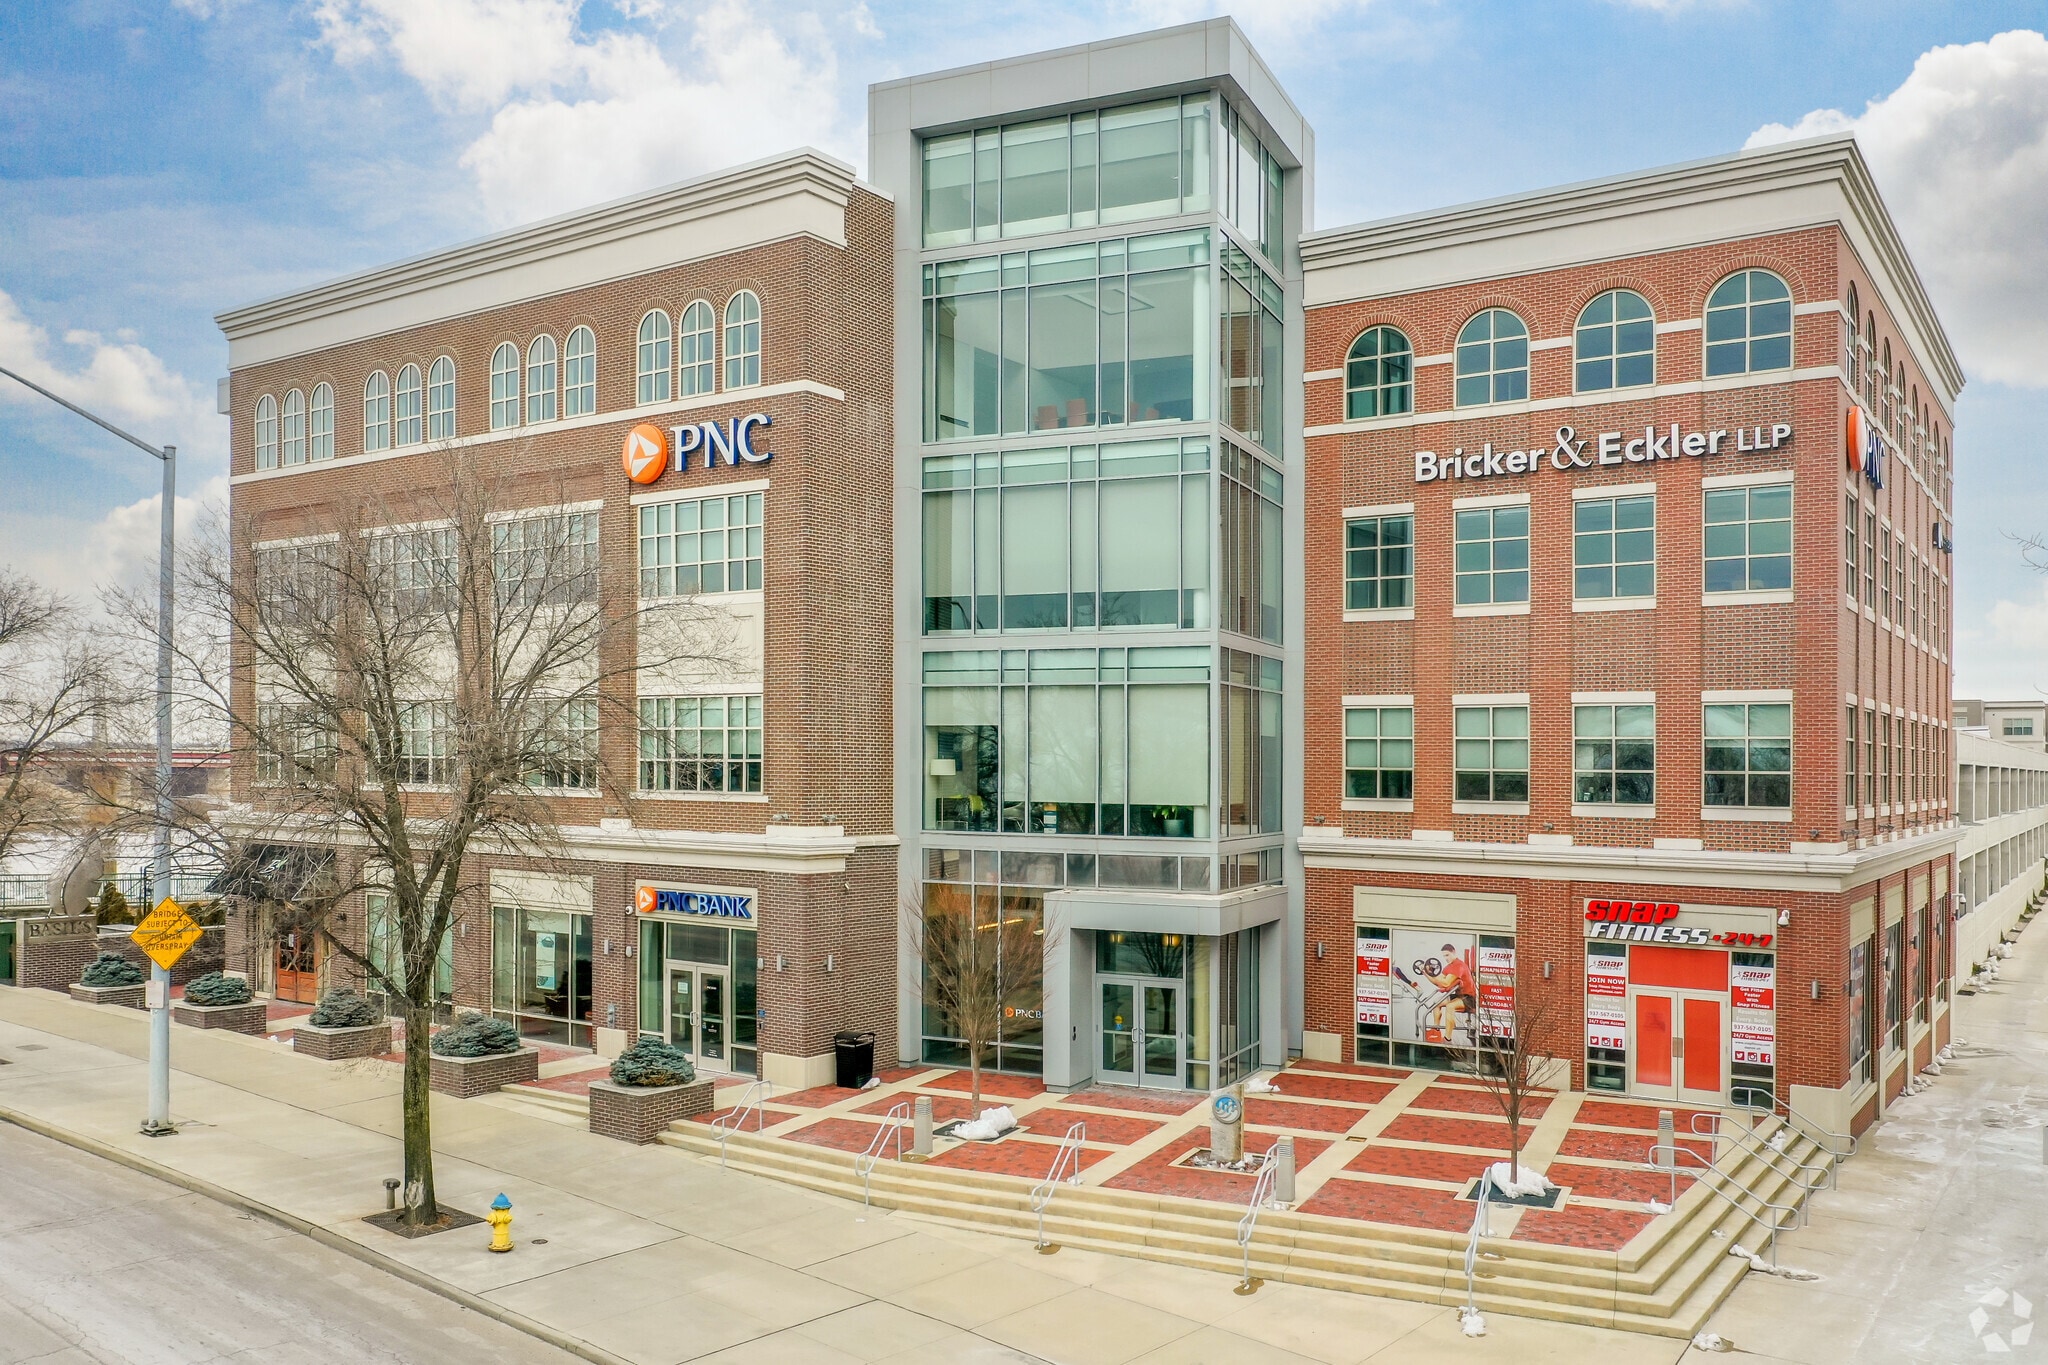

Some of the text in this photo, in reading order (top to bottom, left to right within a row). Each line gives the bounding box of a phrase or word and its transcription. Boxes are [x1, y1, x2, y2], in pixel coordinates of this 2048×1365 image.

[669, 413, 774, 472] PNC
[1414, 423, 1793, 482] Bricker & Eckler LLP
[154, 910, 182, 918] BRIDGE
[146, 919, 180, 928] SUBJECT
[29, 920, 92, 937] BASIL'S
[145, 942, 188, 951] OVERSPRAY
[1733, 1024, 1772, 1032] 937-567-0105
